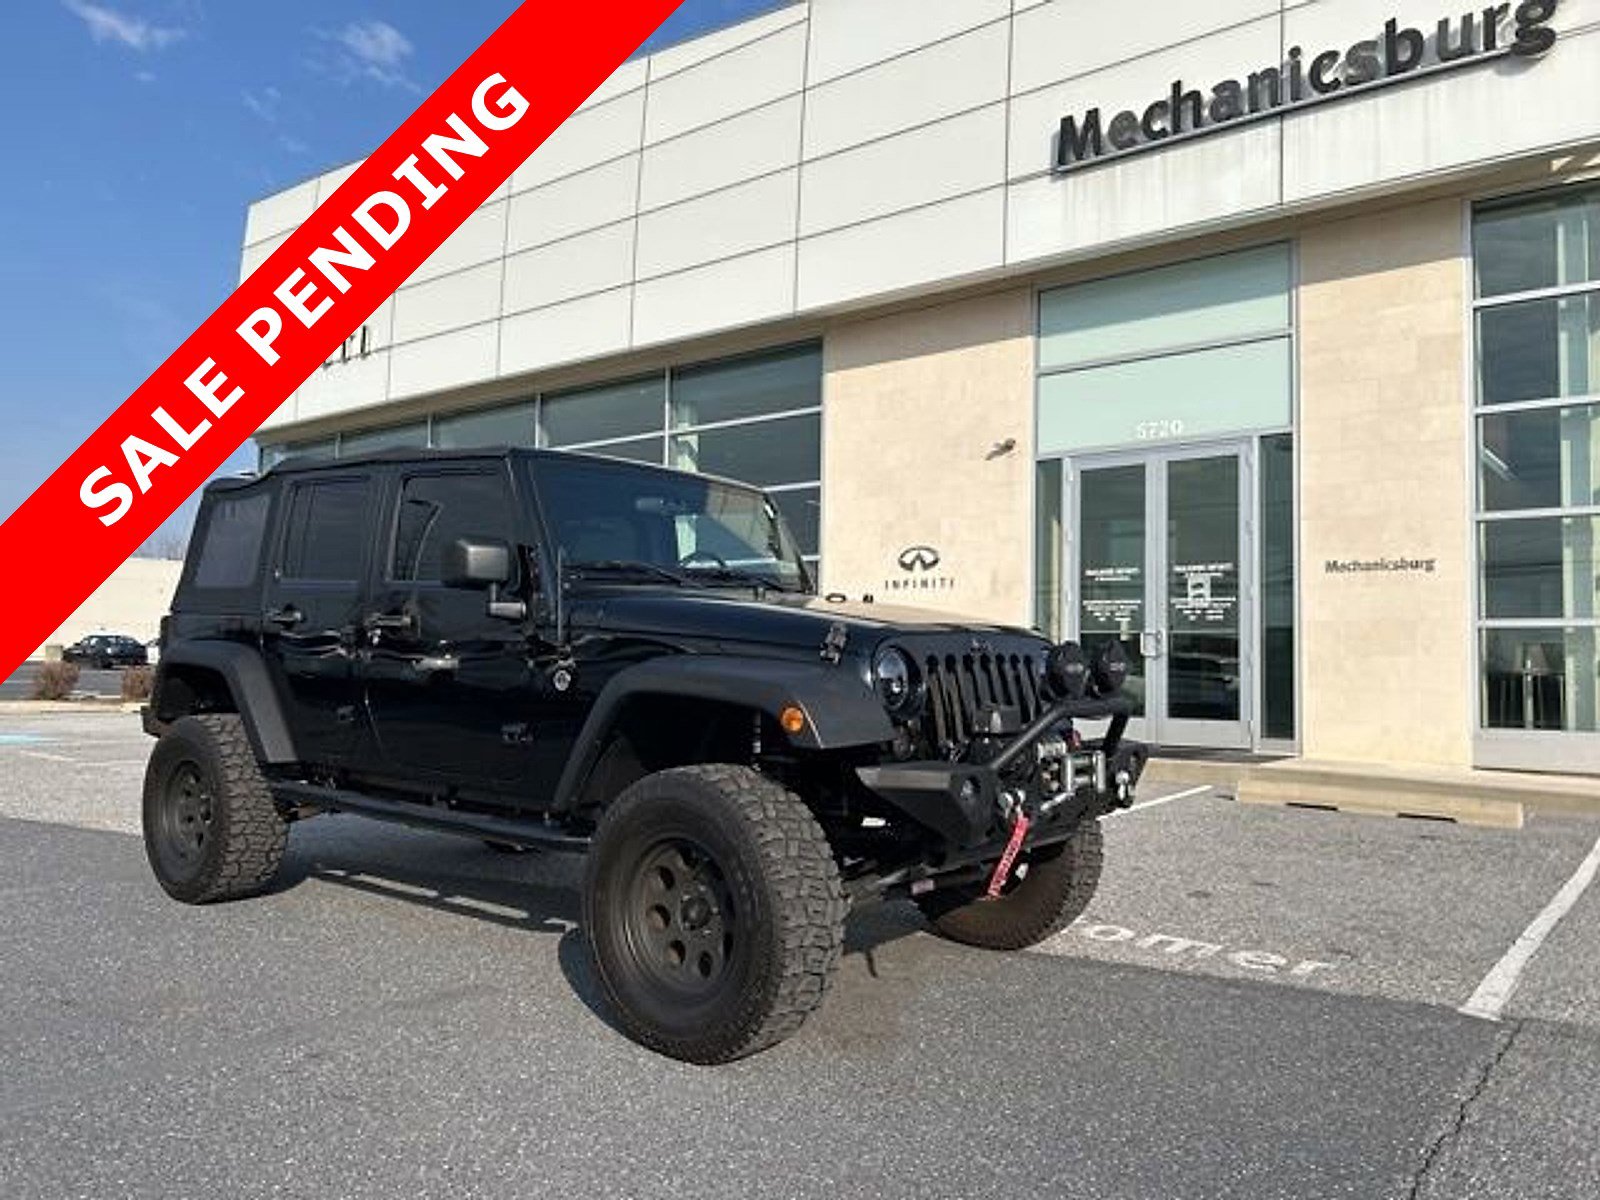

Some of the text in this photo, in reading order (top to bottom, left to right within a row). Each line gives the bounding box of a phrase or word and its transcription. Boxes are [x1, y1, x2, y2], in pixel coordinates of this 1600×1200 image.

[1056, 0, 1558, 166] Mechanicsburg
[1324, 557, 1437, 573] Mechanicsburg
[1082, 921, 1333, 975] omer
